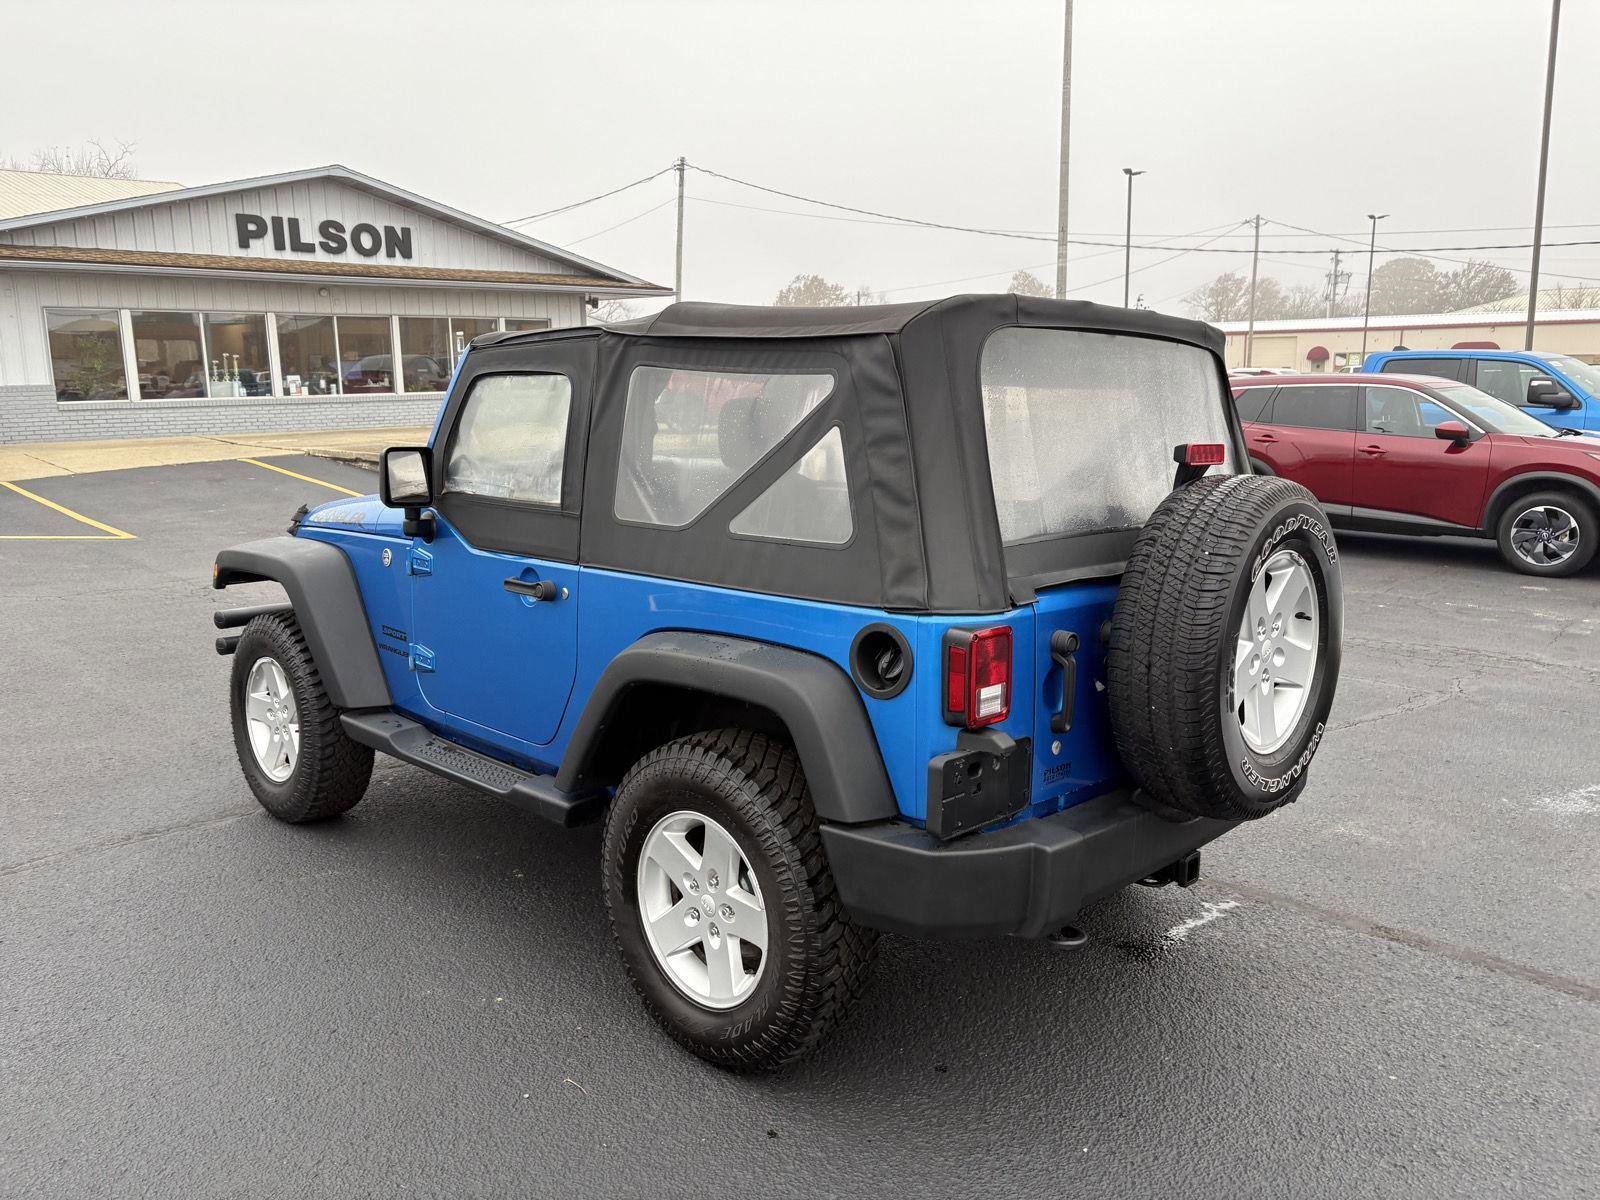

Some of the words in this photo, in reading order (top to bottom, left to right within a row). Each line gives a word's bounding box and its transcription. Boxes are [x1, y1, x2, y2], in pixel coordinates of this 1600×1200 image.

[235, 213, 413, 259] PILSON
[1251, 513, 1337, 582] GOODYEAR
[382, 624, 407, 641] SPORT
[1241, 721, 1325, 793] WRANGLER
